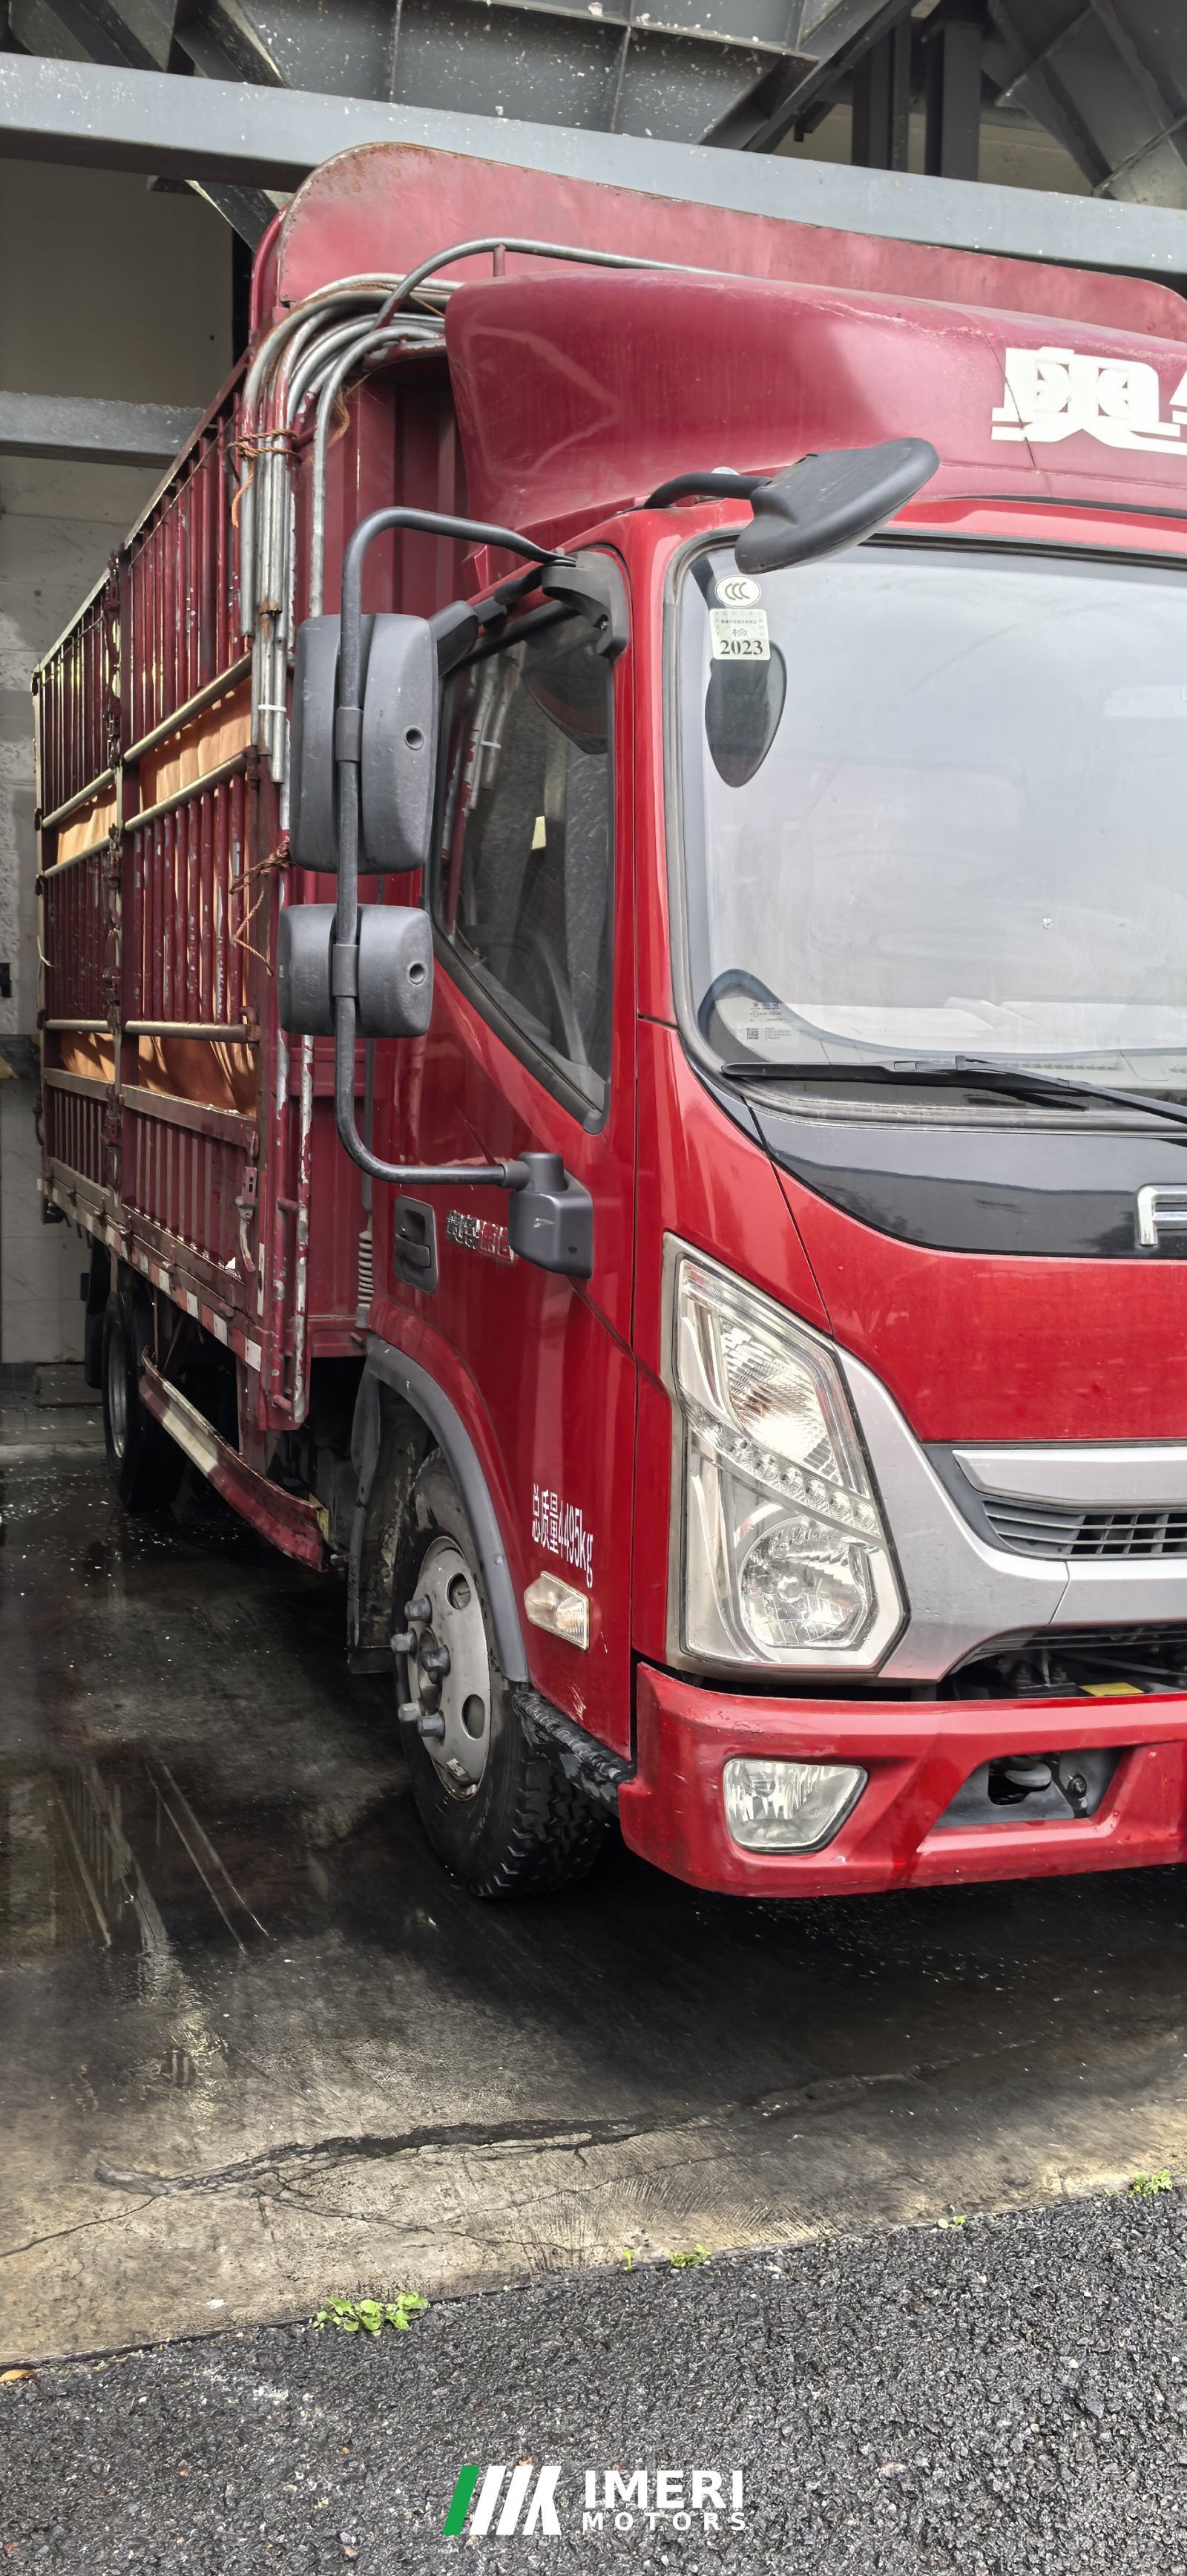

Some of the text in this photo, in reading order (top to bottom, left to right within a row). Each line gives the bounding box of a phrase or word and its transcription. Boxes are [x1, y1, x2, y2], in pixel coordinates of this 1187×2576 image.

[990, 346, 1187, 456] 奥
[720, 640, 763, 655] 2023
[532, 1483, 594, 1589] 总质量4495kg
